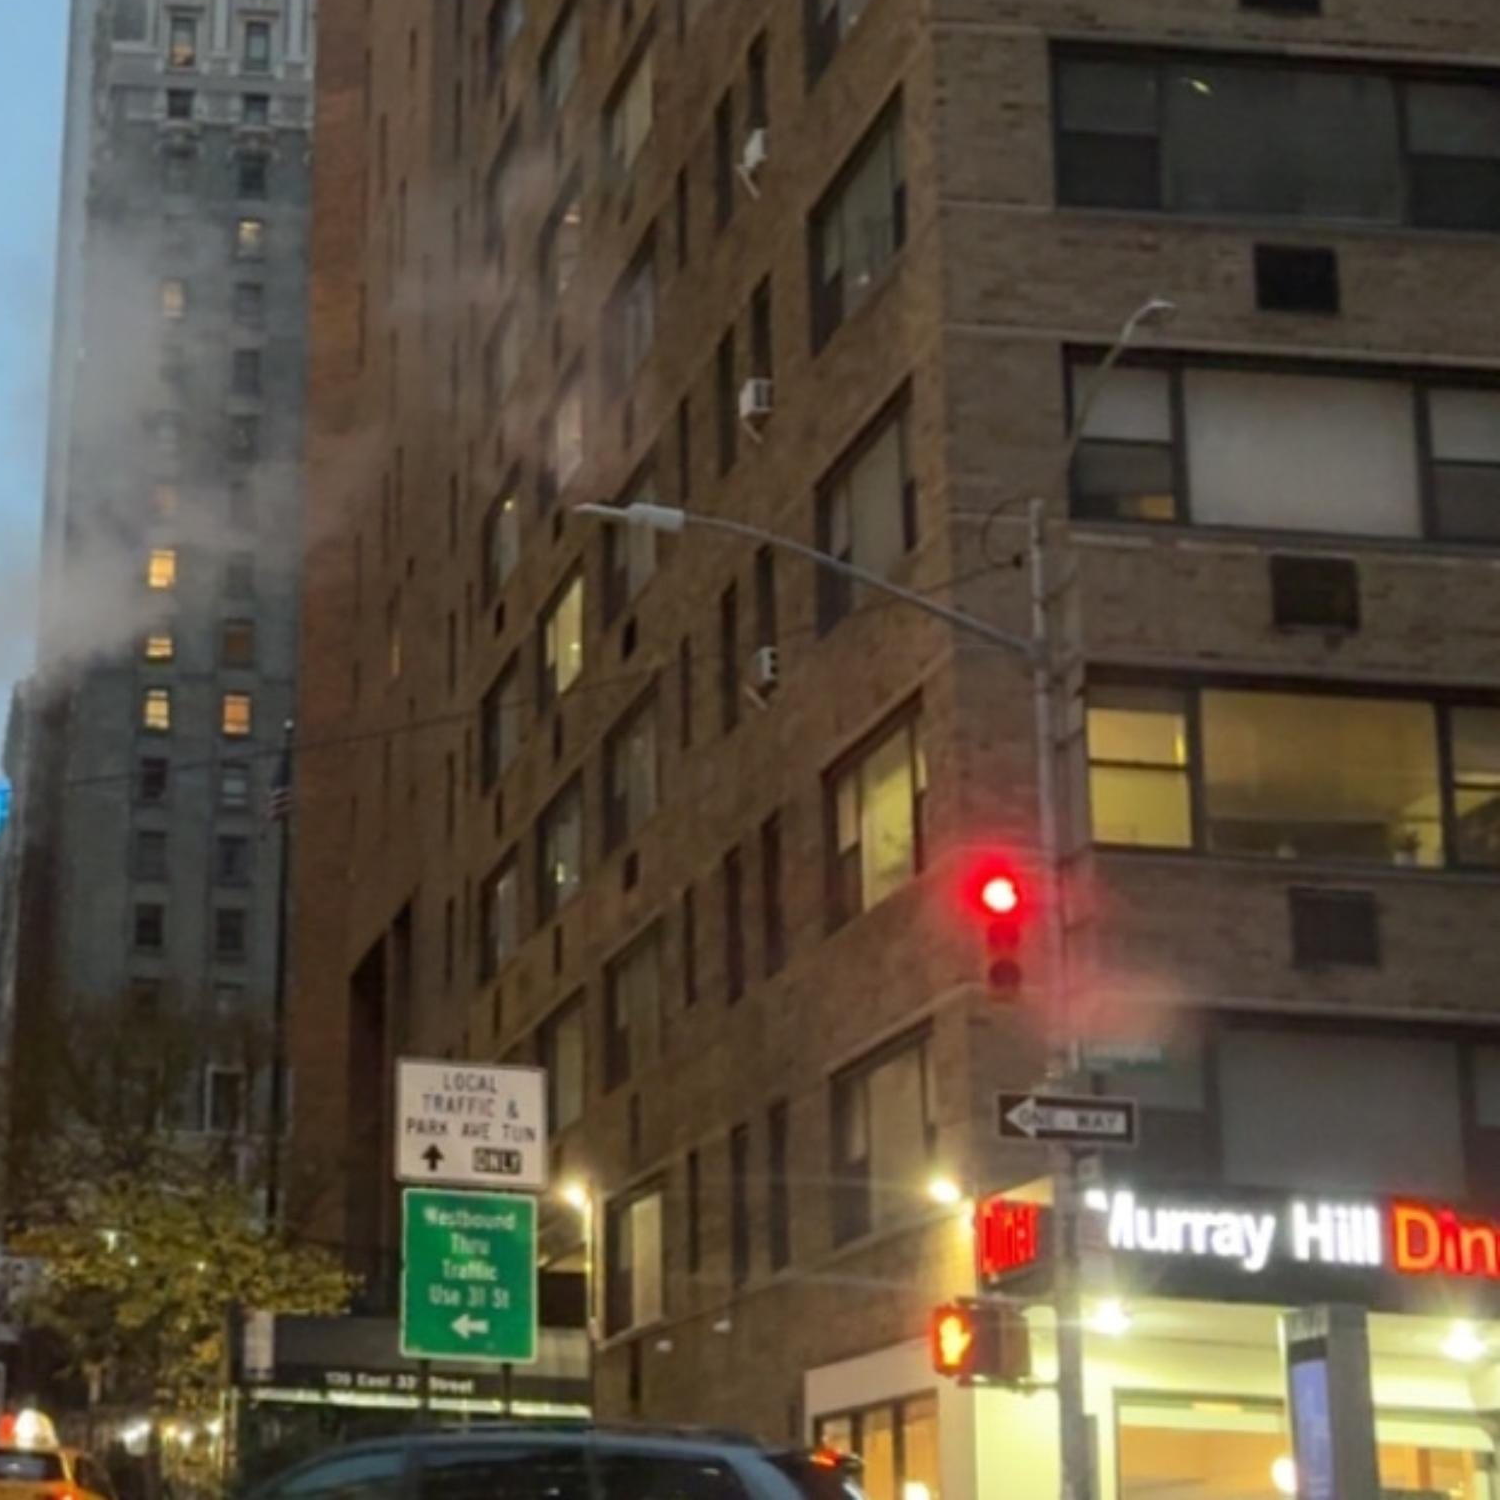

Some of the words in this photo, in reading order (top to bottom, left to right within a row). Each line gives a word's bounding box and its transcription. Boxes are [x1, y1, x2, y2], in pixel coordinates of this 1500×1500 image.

[442, 1072, 498, 1095] LOCAL
[421, 1092, 495, 1118] TRAFFIC
[506, 1100, 520, 1120] &
[405, 1116, 448, 1136] PARK
[461, 1121, 491, 1141] AVE
[501, 1122, 537, 1143] TUN
[1077, 1110, 1117, 1130] WAY
[474, 1148, 521, 1174] ONLY
[422, 1206, 517, 1231] Westbound
[450, 1232, 492, 1256] Thru
[1085, 1189, 1276, 1271] Murray
[1291, 1199, 1383, 1267] Hill
[1392, 1198, 1500, 1279] Din
[441, 1258, 498, 1281] Traffic
[428, 1284, 462, 1307] Use
[491, 1287, 511, 1309] St
[427, 1374, 475, 1394] Street
